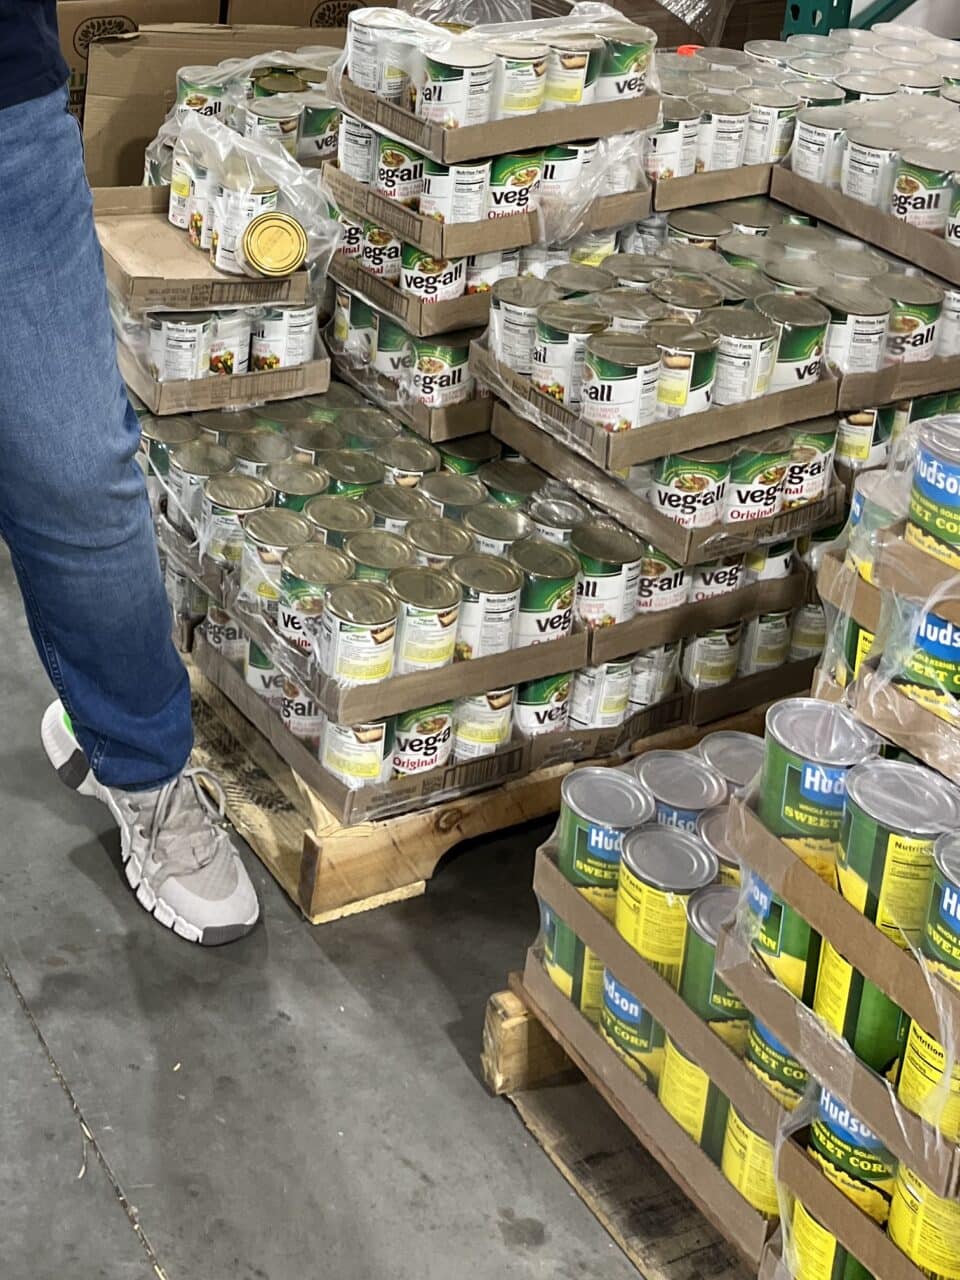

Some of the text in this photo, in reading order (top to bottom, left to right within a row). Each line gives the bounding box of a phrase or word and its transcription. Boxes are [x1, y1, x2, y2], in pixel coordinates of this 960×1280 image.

[730, 505, 776, 521] Original
[392, 754, 439, 771] Original
[804, 767, 845, 795] Hud
[657, 811, 697, 834] udso
[759, 932, 777, 950] RN
[712, 994, 742, 1009] SWE
[613, 1026, 649, 1049] CORN
[820, 1087, 875, 1139] Hudso
